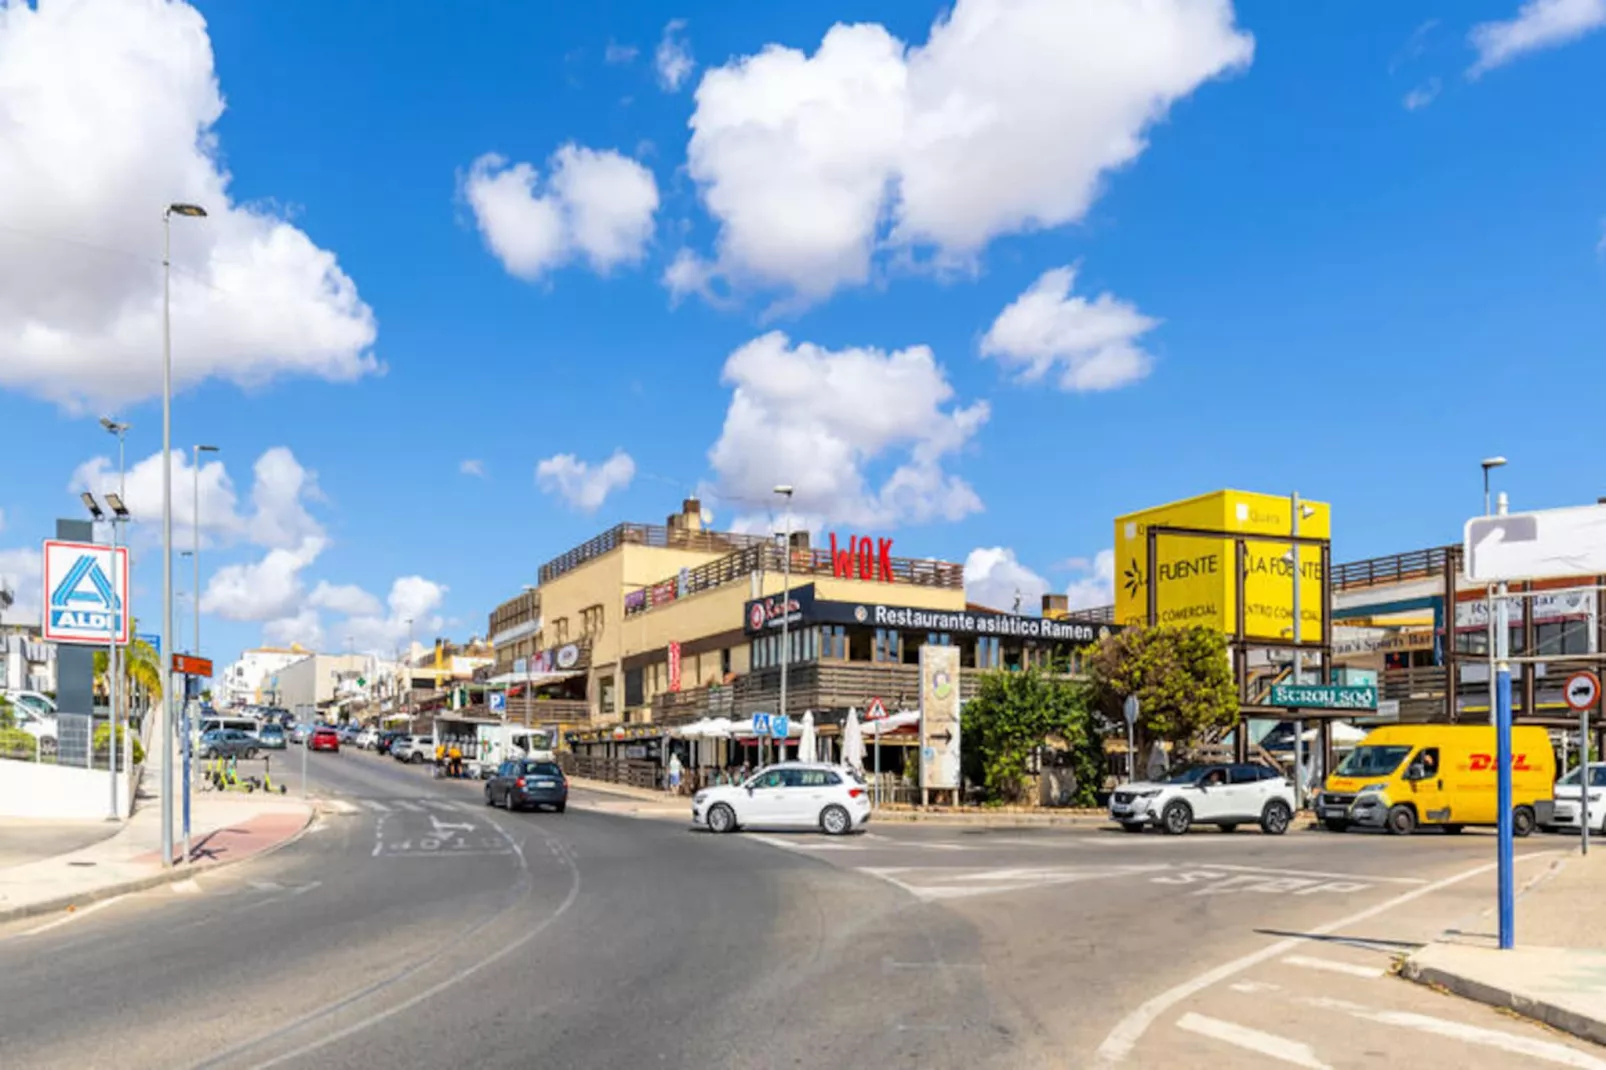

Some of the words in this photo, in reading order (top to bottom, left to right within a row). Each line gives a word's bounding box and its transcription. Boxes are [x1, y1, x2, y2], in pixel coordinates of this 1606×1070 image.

[829, 531, 894, 582] WOK
[1250, 555, 1267, 574] LA
[1159, 554, 1217, 582] FUENTE
[57, 611, 112, 629] ALDI
[1162, 604, 1217, 622] COMERCIAL
[1245, 604, 1272, 618] NTRO
[875, 605, 974, 630] Restaurante
[977, 614, 1039, 635] asiático
[1040, 620, 1094, 640] Ramen
[1331, 640, 1360, 654] yan's
